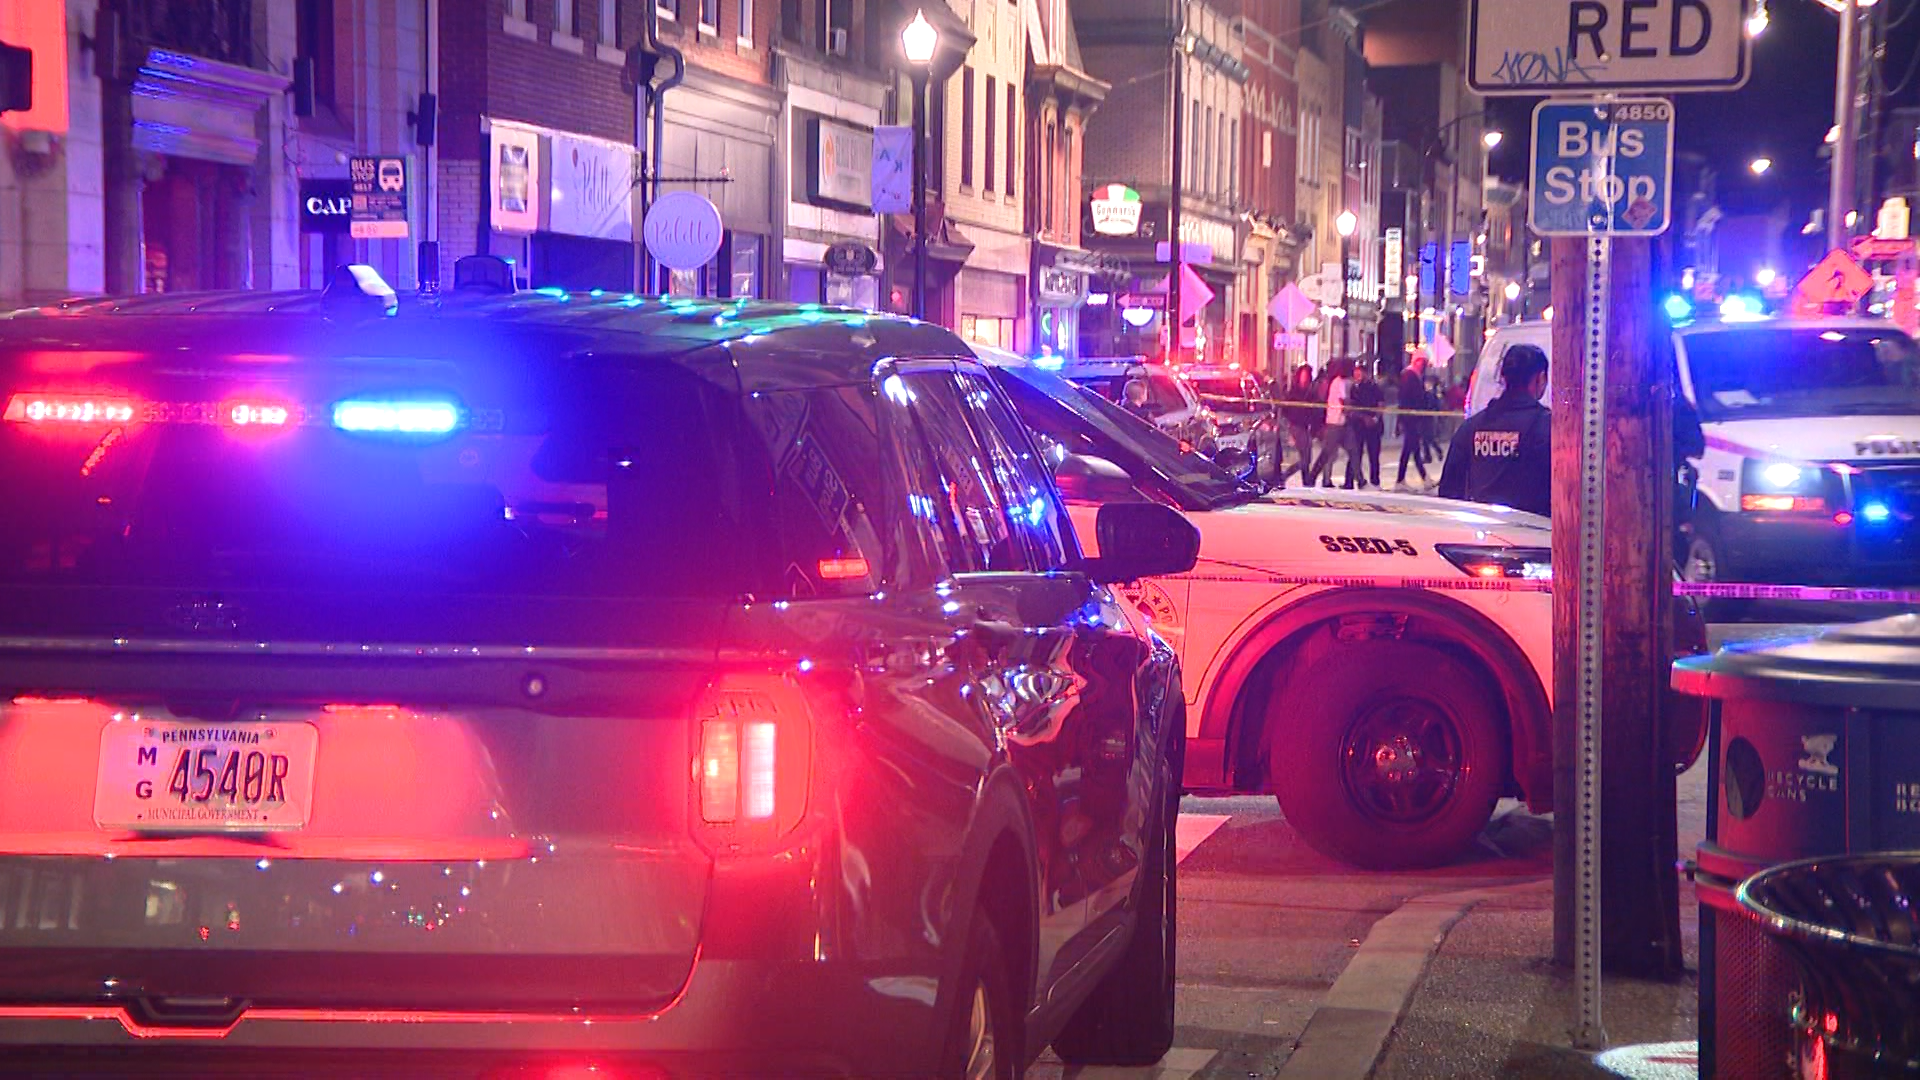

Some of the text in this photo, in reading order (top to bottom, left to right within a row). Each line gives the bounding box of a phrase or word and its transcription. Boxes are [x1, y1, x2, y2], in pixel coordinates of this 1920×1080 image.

[1568, 1, 1713, 58] RED
[1615, 105, 1669, 121] 4850
[1558, 121, 1644, 158] Bus
[1544, 166, 1656, 208] Stop
[1319, 535, 1418, 556] SSED-5
[162, 729, 259, 744] PENNSYLVANIA
[137, 747, 158, 766] M
[168, 748, 289, 803] 4540R
[135, 781, 153, 798] G
[148, 807, 258, 820] MUNICIPAL GOVERNMENT
